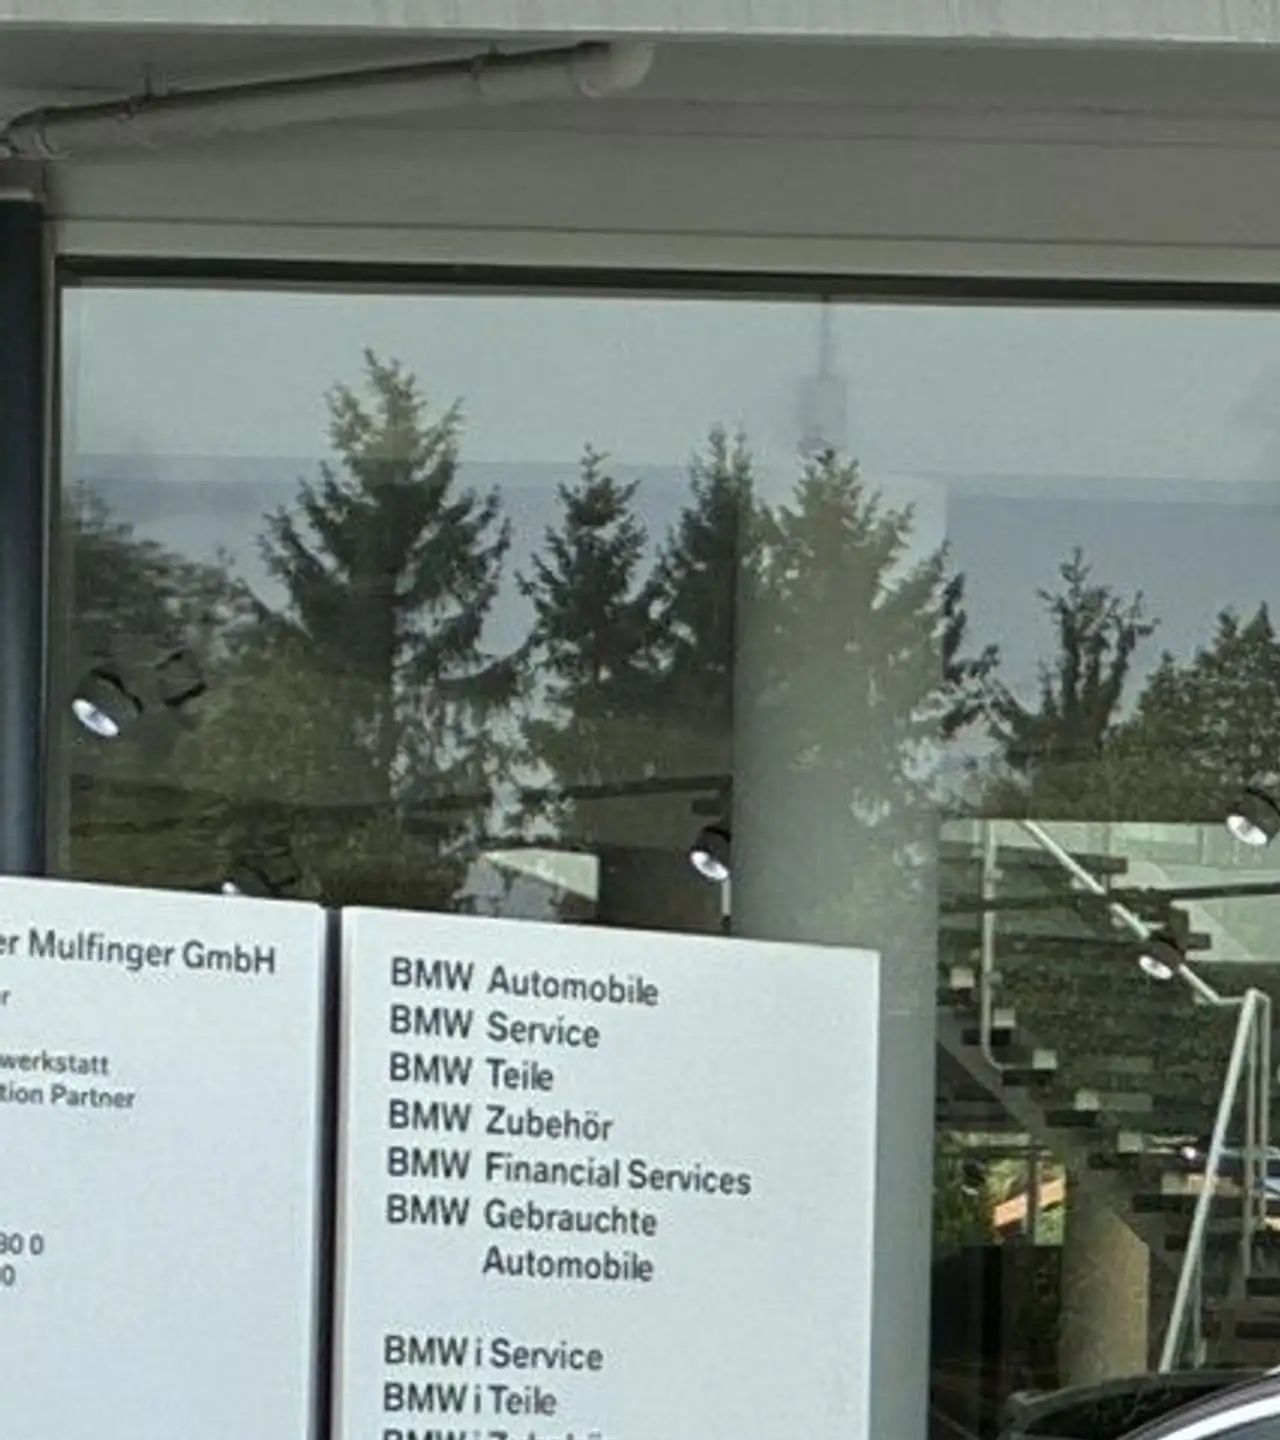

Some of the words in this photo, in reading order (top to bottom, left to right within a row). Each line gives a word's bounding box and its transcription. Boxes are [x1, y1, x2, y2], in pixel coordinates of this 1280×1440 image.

[29, 927, 176, 973] Mulfinger
[182, 939, 276, 975] GmbH
[391, 956, 474, 992] BMW
[488, 965, 658, 1006] Automobile
[390, 1004, 473, 1039] BMW
[487, 1011, 600, 1049] Service
[389, 1051, 473, 1086] BMW
[486, 1057, 554, 1091] Teile
[50, 1083, 136, 1109] Partner
[389, 1098, 471, 1133] BMW
[485, 1104, 613, 1141] Zubehör
[387, 1146, 470, 1179] BMW
[485, 1151, 620, 1187] Financial
[627, 1159, 752, 1196] Services
[386, 1193, 470, 1226] BMW
[484, 1198, 657, 1237] Gebrauchte
[30, 1233, 45, 1256] 0
[482, 1245, 654, 1282] Automobile
[384, 1334, 468, 1367] BMW
[489, 1337, 603, 1371] Service
[383, 1382, 468, 1413] BMW
[488, 1384, 557, 1416] Teile
